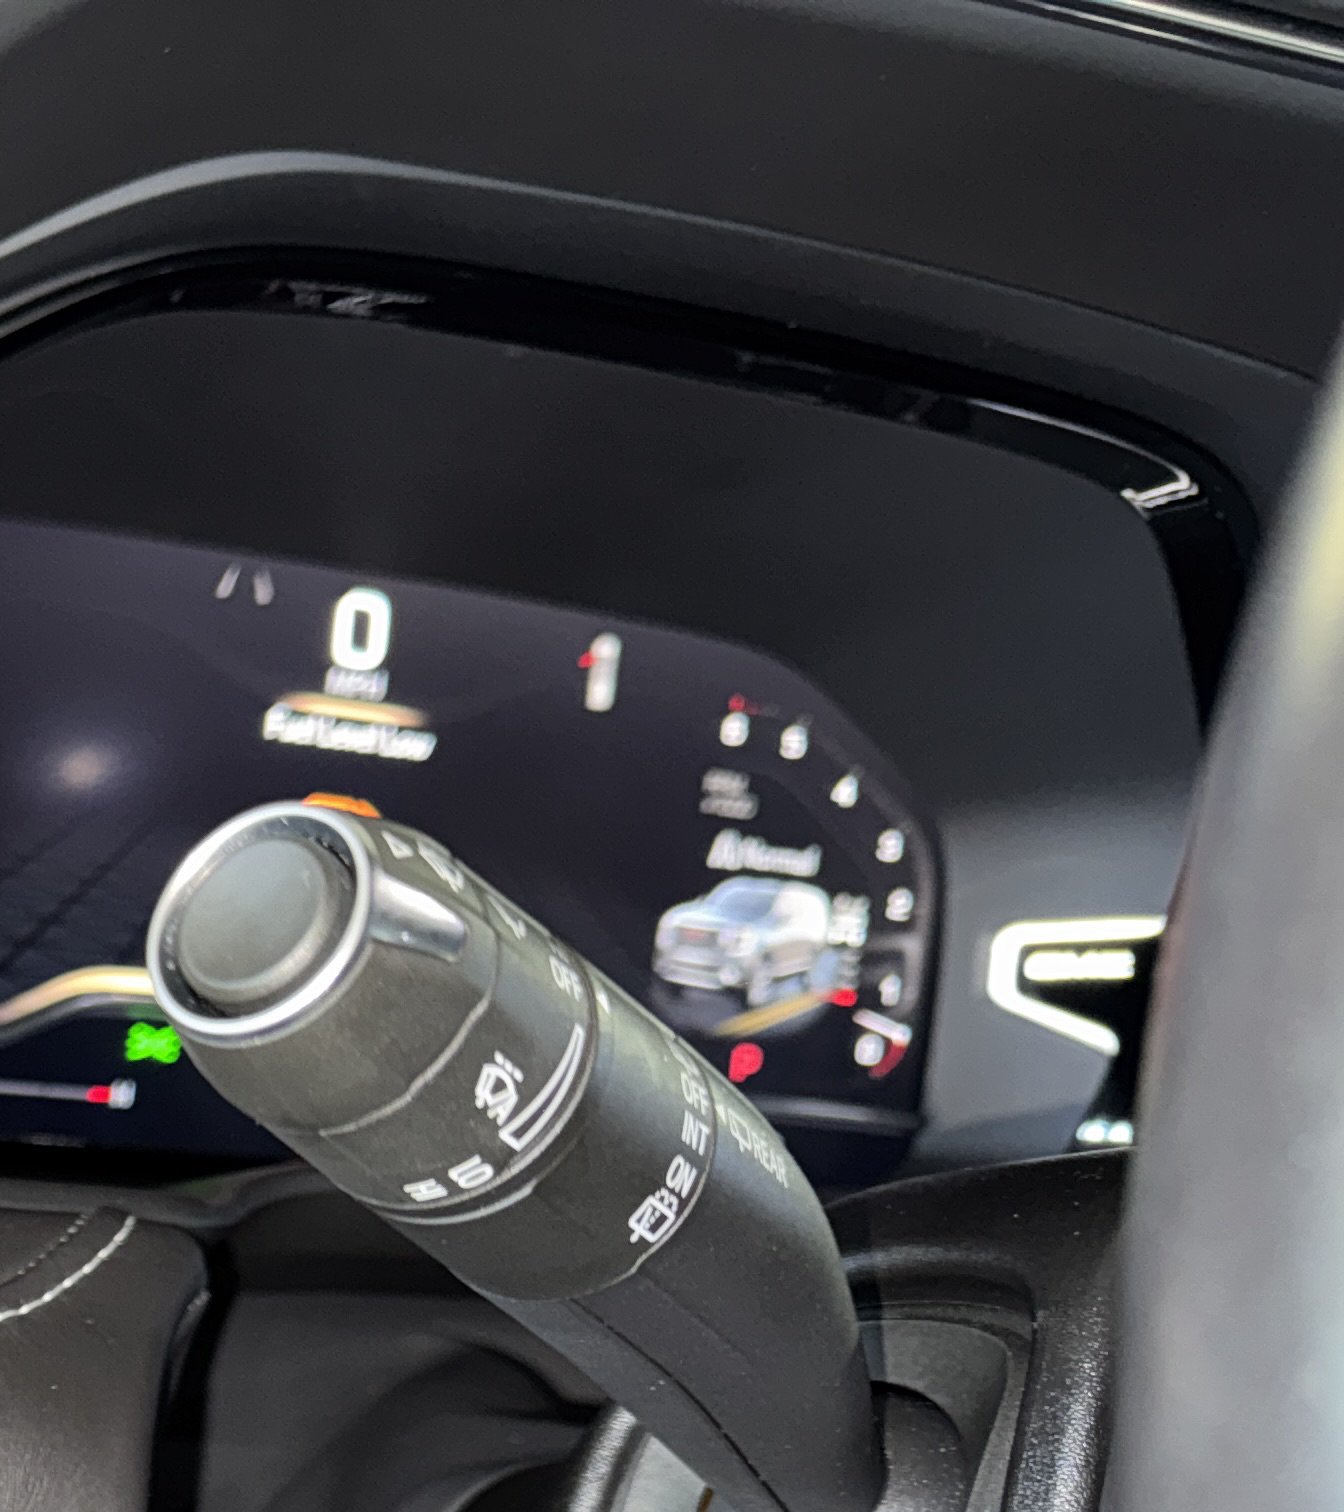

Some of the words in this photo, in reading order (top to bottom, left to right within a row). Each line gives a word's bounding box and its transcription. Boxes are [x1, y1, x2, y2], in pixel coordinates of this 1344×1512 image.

[330, 584, 393, 671] 0
[680, 1071, 710, 1117] OFF
[681, 1109, 711, 1156] INT
[448, 1154, 494, 1189] LO
[665, 1154, 698, 1199] ON
[751, 1131, 789, 1189] REAR
[403, 1178, 448, 1202] HI
